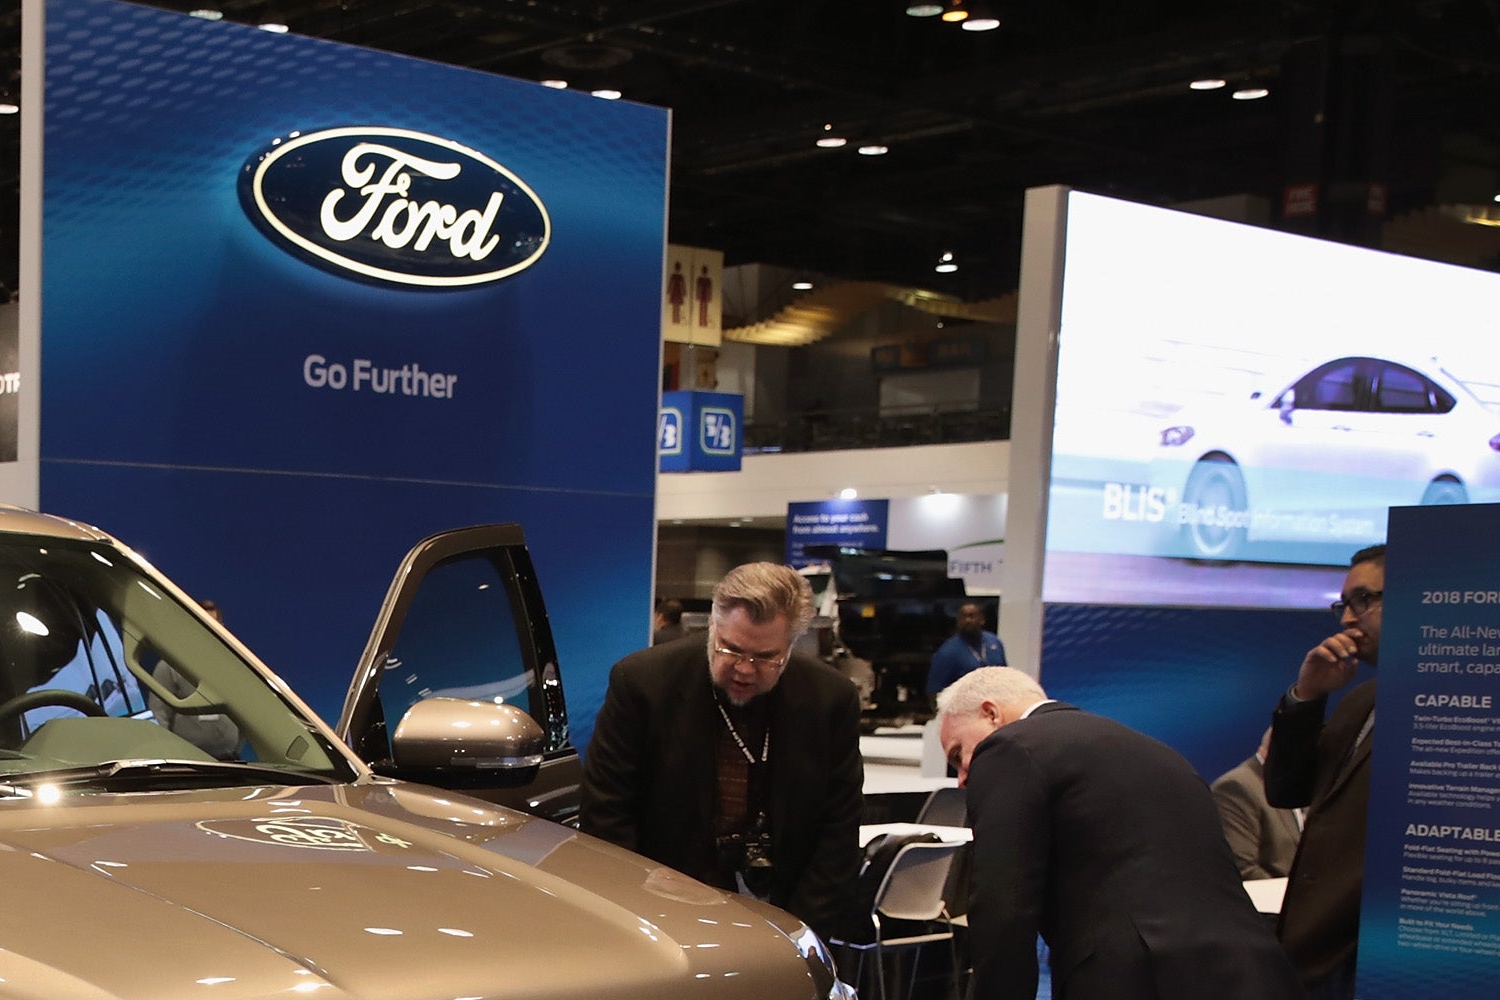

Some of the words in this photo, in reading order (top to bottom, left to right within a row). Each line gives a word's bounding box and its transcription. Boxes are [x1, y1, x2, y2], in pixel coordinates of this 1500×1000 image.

[319, 142, 504, 262] Ford
[303, 354, 348, 390] Go
[353, 359, 458, 399] Further
[1421, 591, 1461, 604] 2018
[1463, 591, 1500, 604] FOR
[1420, 625, 1448, 638] The
[1418, 643, 1480, 656] ultimate
[1416, 661, 1464, 674] smart,
[1414, 694, 1492, 708] CAPABLE
[1405, 823, 1500, 842] ADAPTABLE
